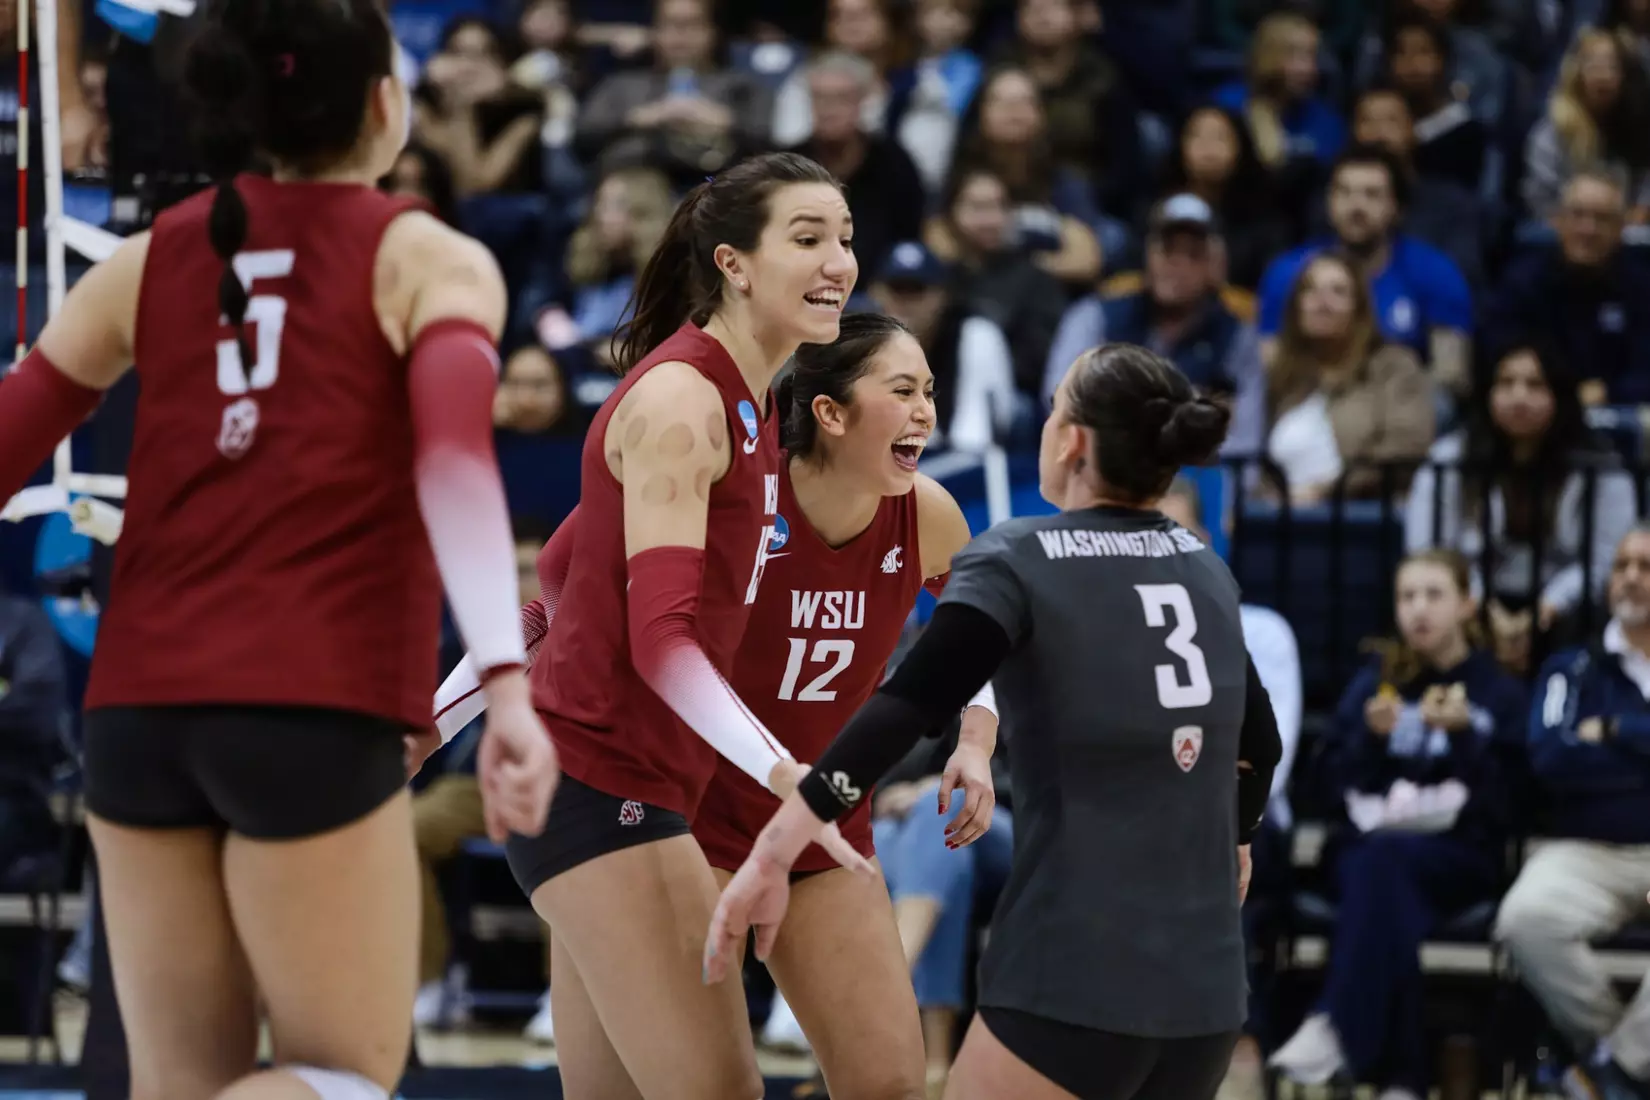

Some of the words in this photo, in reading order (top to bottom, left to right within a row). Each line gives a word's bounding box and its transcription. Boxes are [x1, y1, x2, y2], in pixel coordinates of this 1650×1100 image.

[216, 248, 296, 396] 5
[1035, 529, 1177, 560] WASHINGTON
[790, 589, 866, 629] WSU
[777, 637, 856, 702] 12
[1132, 583, 1213, 709] 3
